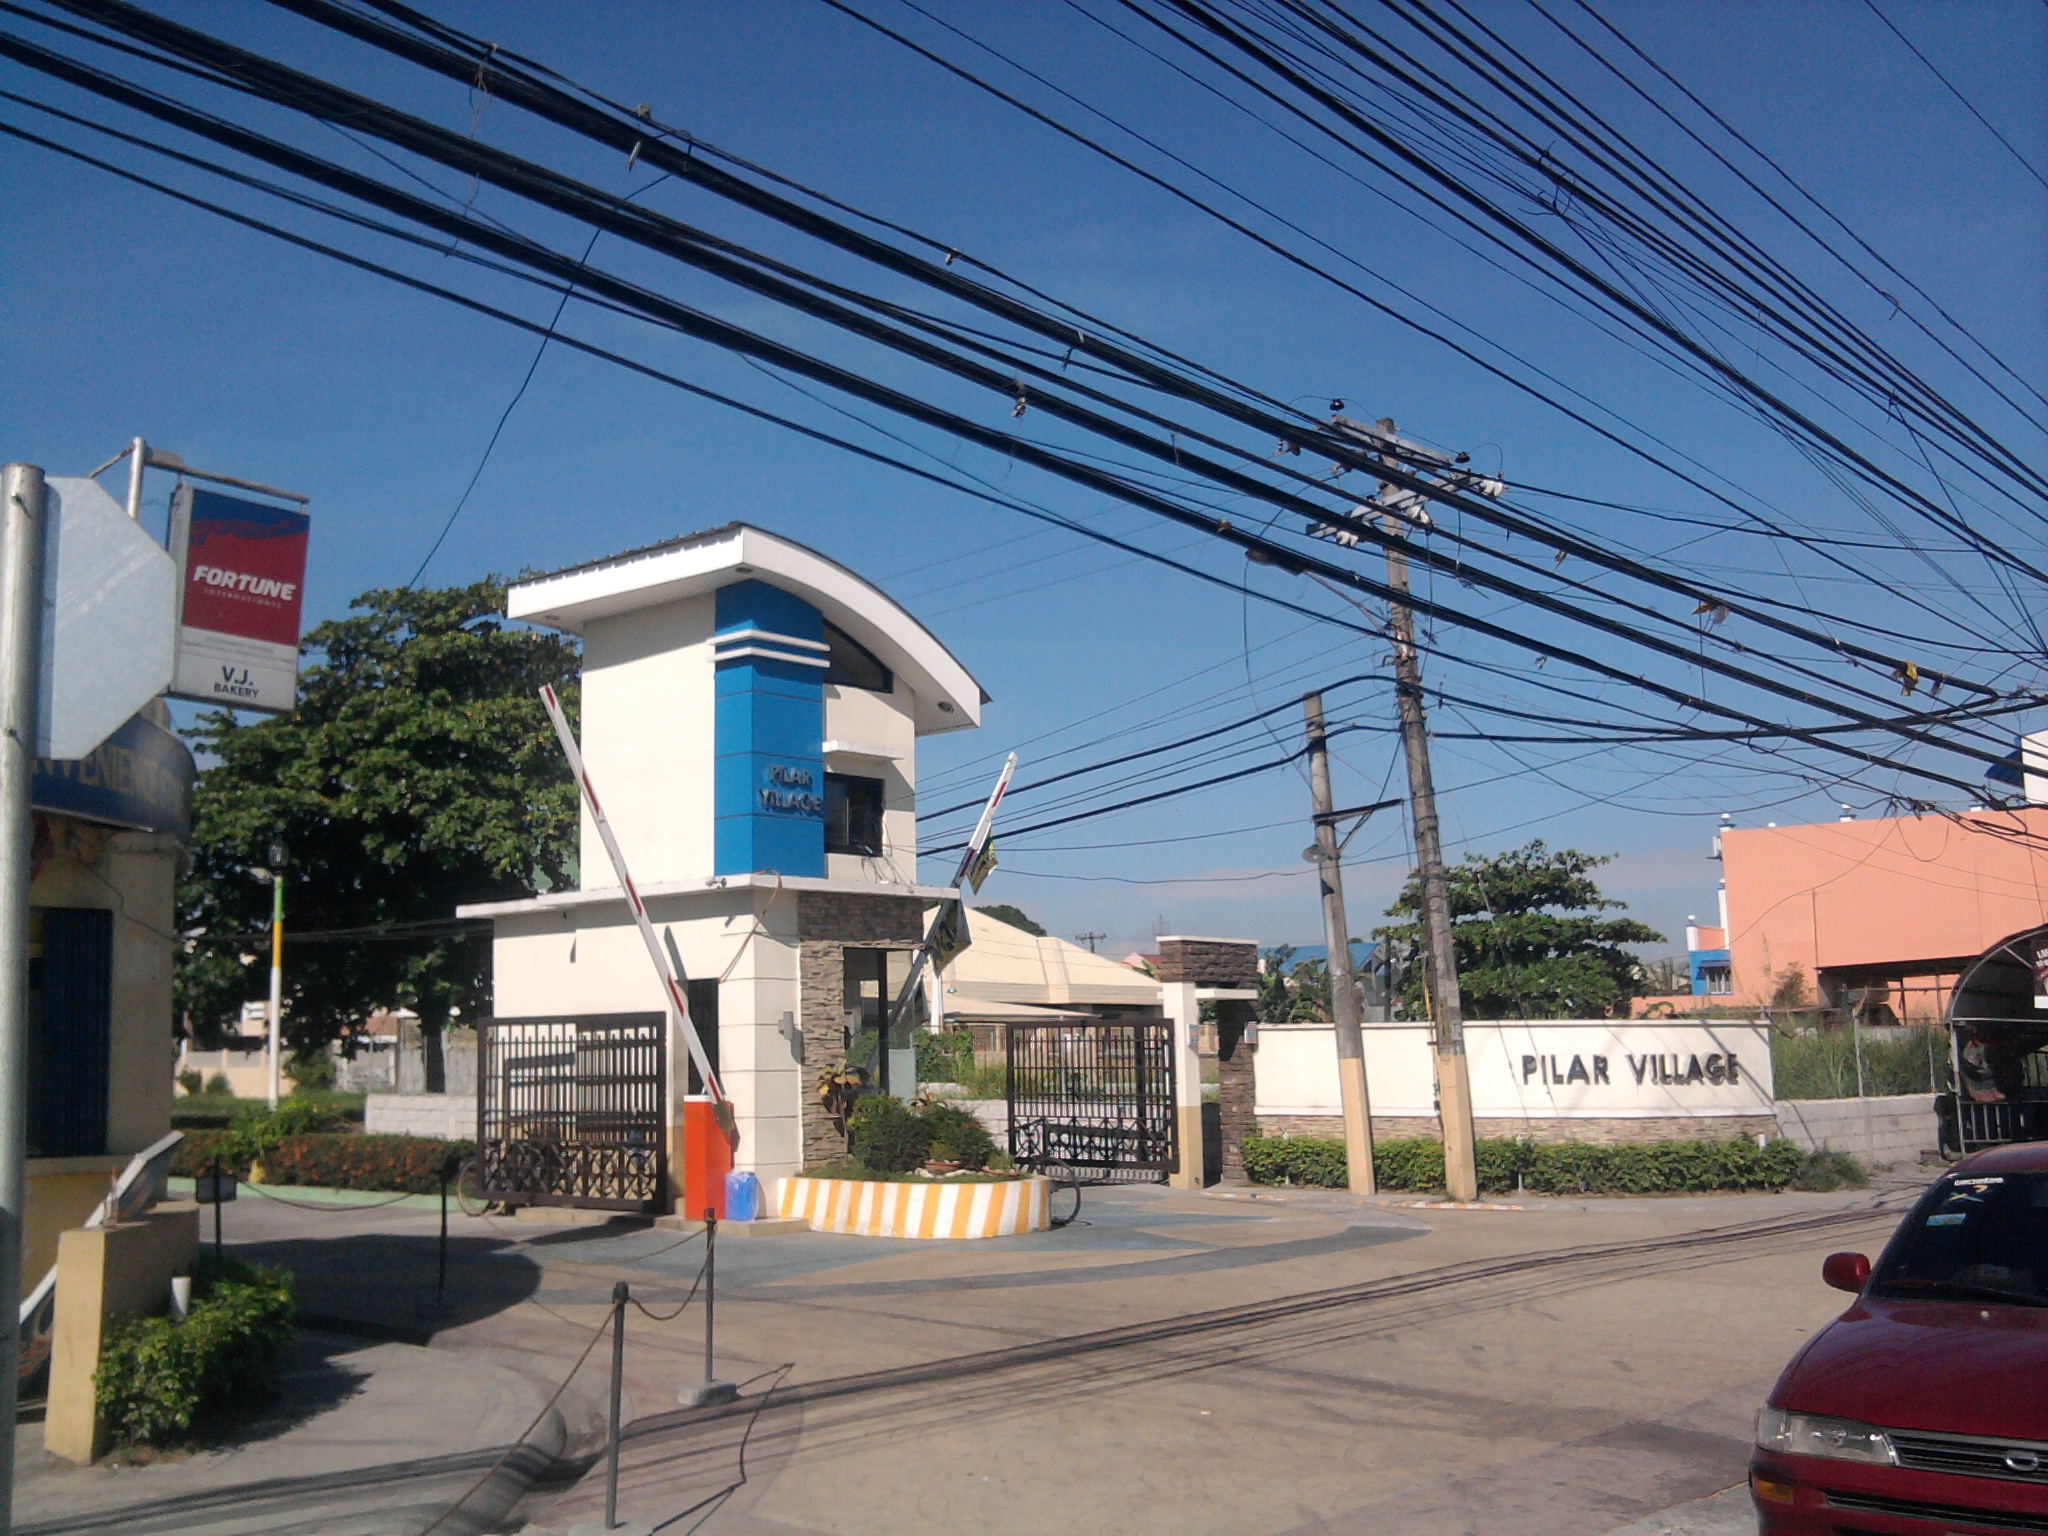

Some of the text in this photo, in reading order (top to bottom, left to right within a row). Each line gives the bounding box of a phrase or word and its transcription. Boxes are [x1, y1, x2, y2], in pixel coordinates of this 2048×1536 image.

[192, 565, 296, 601] FORTUNE
[214, 683, 259, 699] BAKERY
[769, 764, 812, 787] PILAR
[758, 788, 822, 813] VILLAGE
[1521, 1053, 1739, 1087] PILAR VILLAGE
